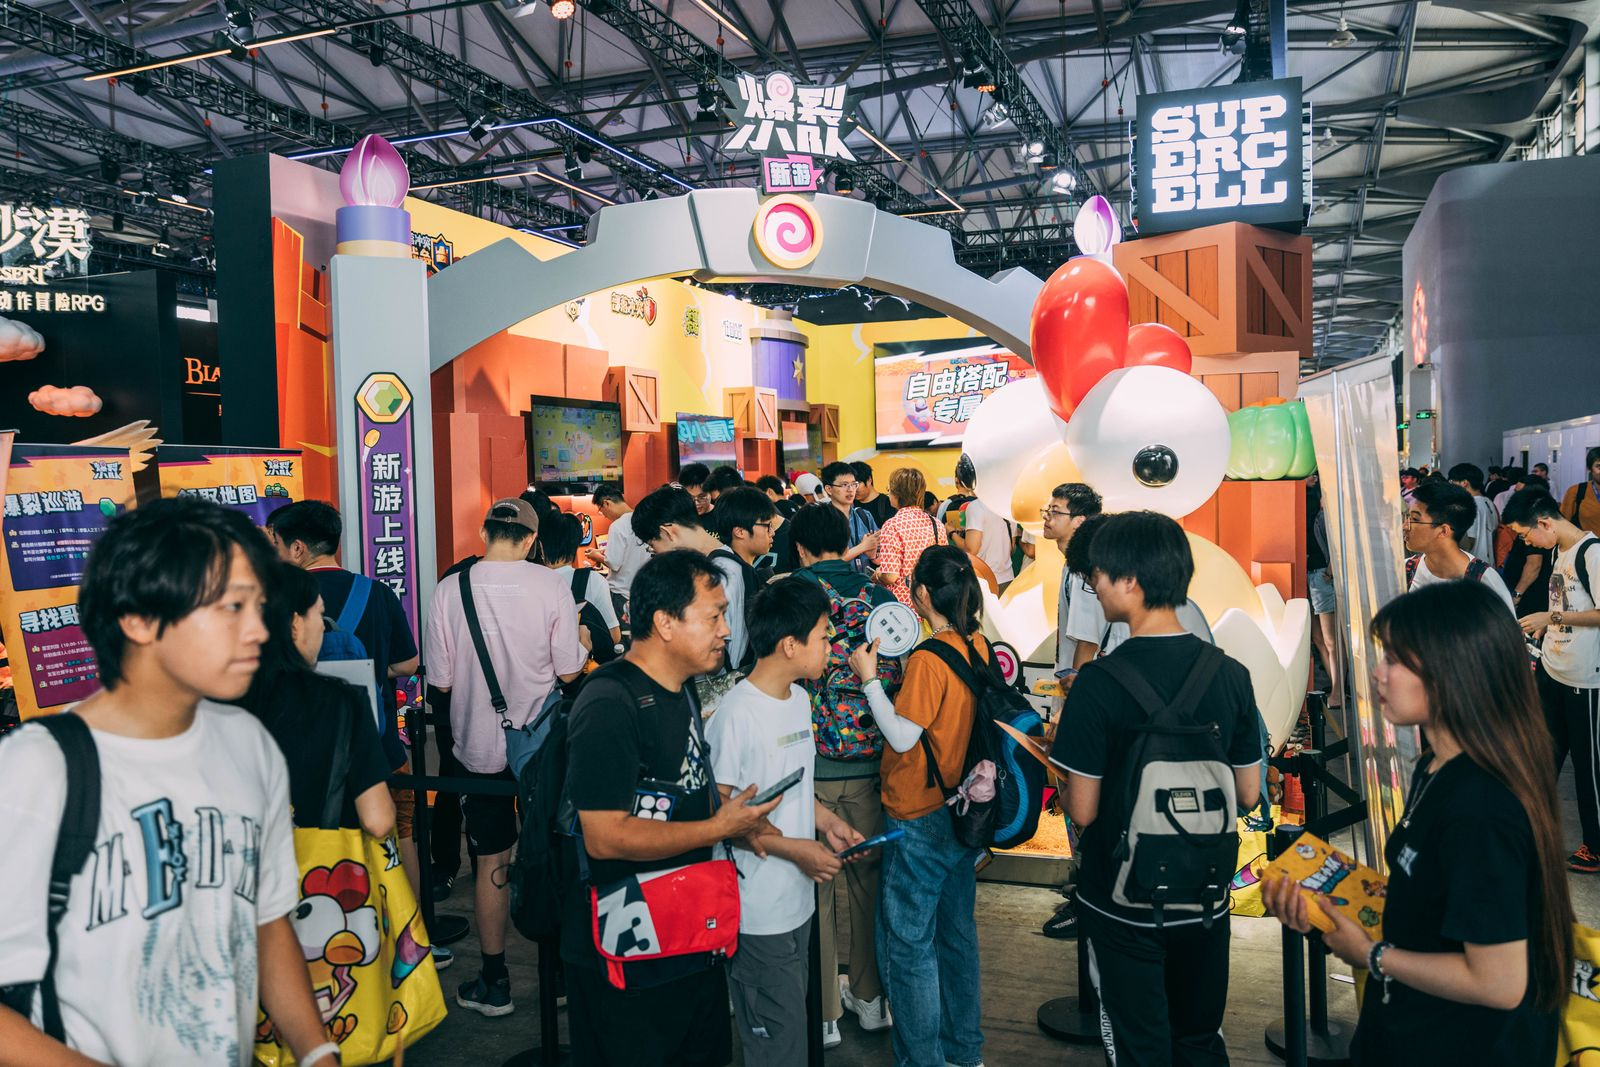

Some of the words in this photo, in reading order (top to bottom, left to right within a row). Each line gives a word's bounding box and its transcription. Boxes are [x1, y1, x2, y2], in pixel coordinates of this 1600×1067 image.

[737, 74, 848, 126] 爆裂
[1151, 95, 1287, 144] SUP
[722, 119, 858, 162] 小队
[1151, 130, 1287, 179] ERC
[770, 162, 811, 187] 新游
[1151, 168, 1287, 214] ELL
[907, 361, 1009, 400] 自由搭配
[3, 490, 83, 517] 爆裂巡游
